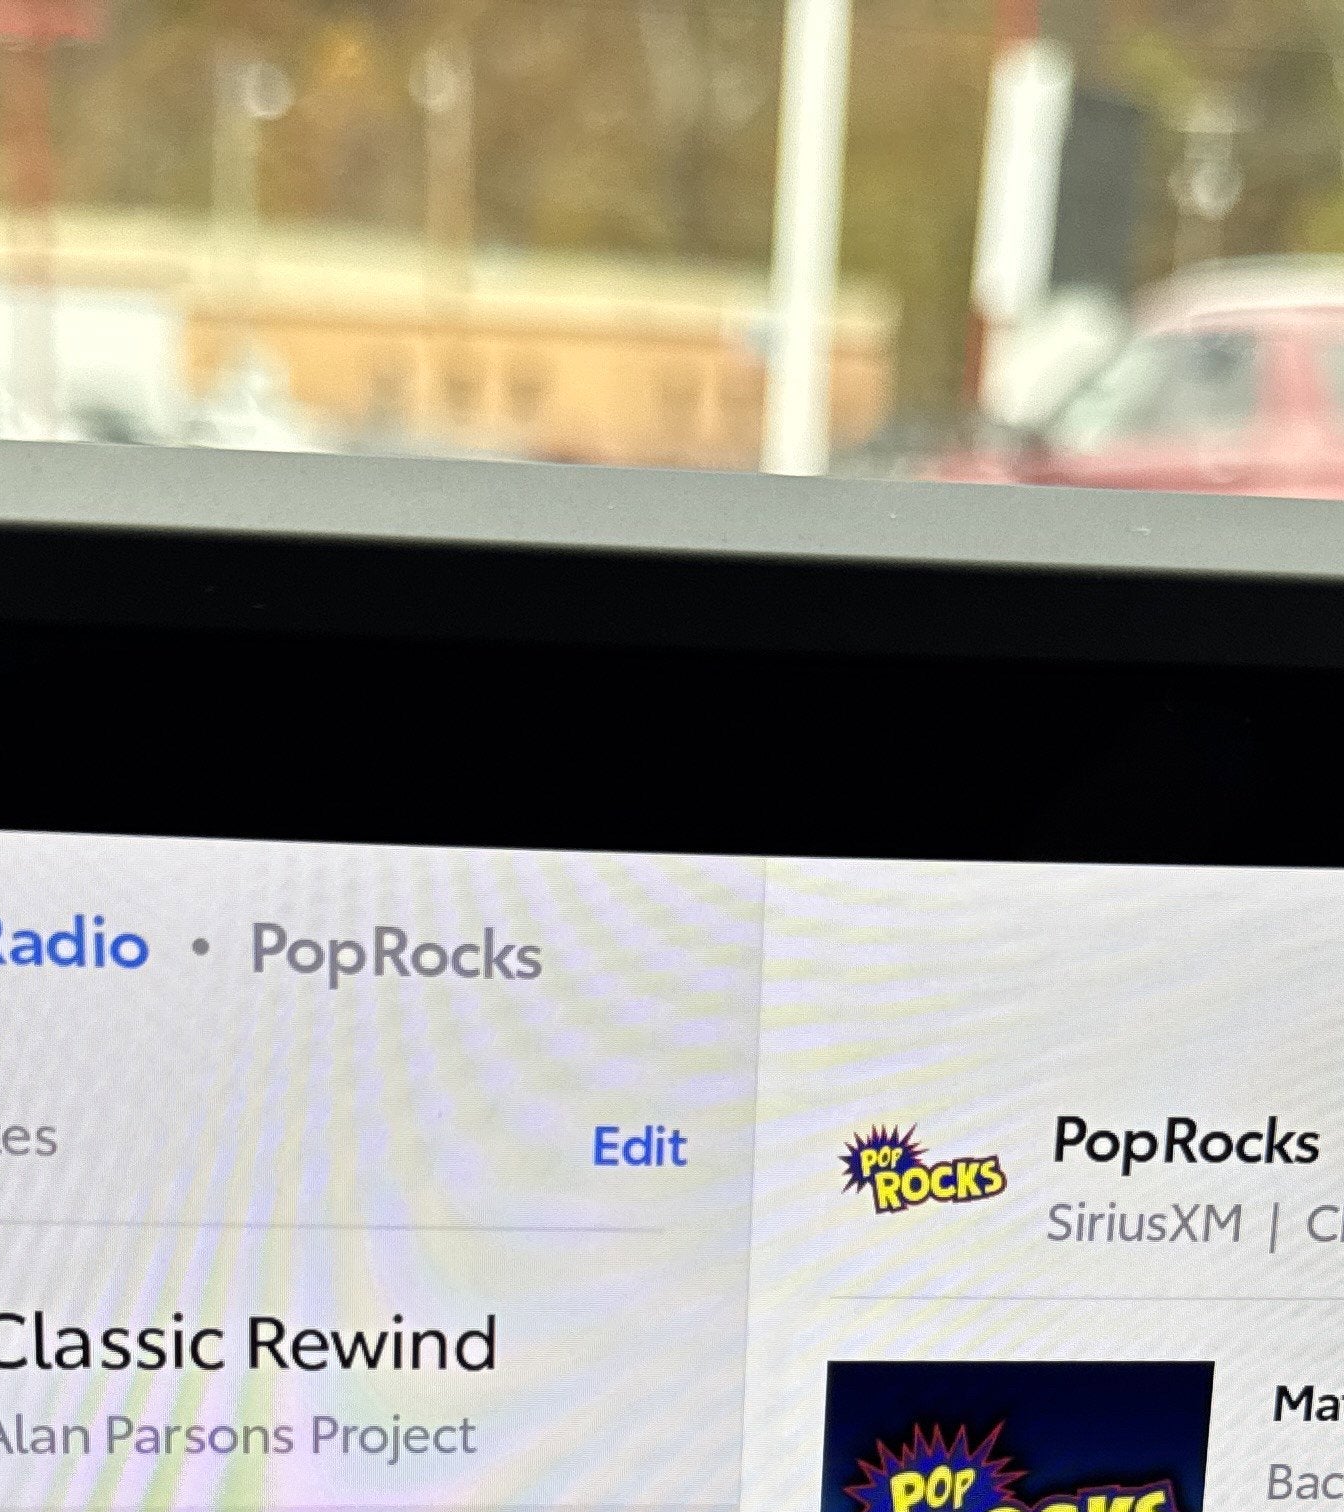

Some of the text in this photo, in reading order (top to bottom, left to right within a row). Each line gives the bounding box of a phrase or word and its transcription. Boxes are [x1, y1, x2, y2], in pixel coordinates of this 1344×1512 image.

[252, 924, 544, 988] PopRocks
[593, 1126, 688, 1168] Edit
[860, 1145, 902, 1177] POP
[1054, 1116, 1321, 1175] PopRocks
[875, 1161, 1003, 1209] ROCKS
[1046, 1203, 1244, 1246] SiriusXM
[248, 1315, 497, 1371] Rewind
[106, 1415, 294, 1456] Parsons
[312, 1413, 477, 1464] Project
